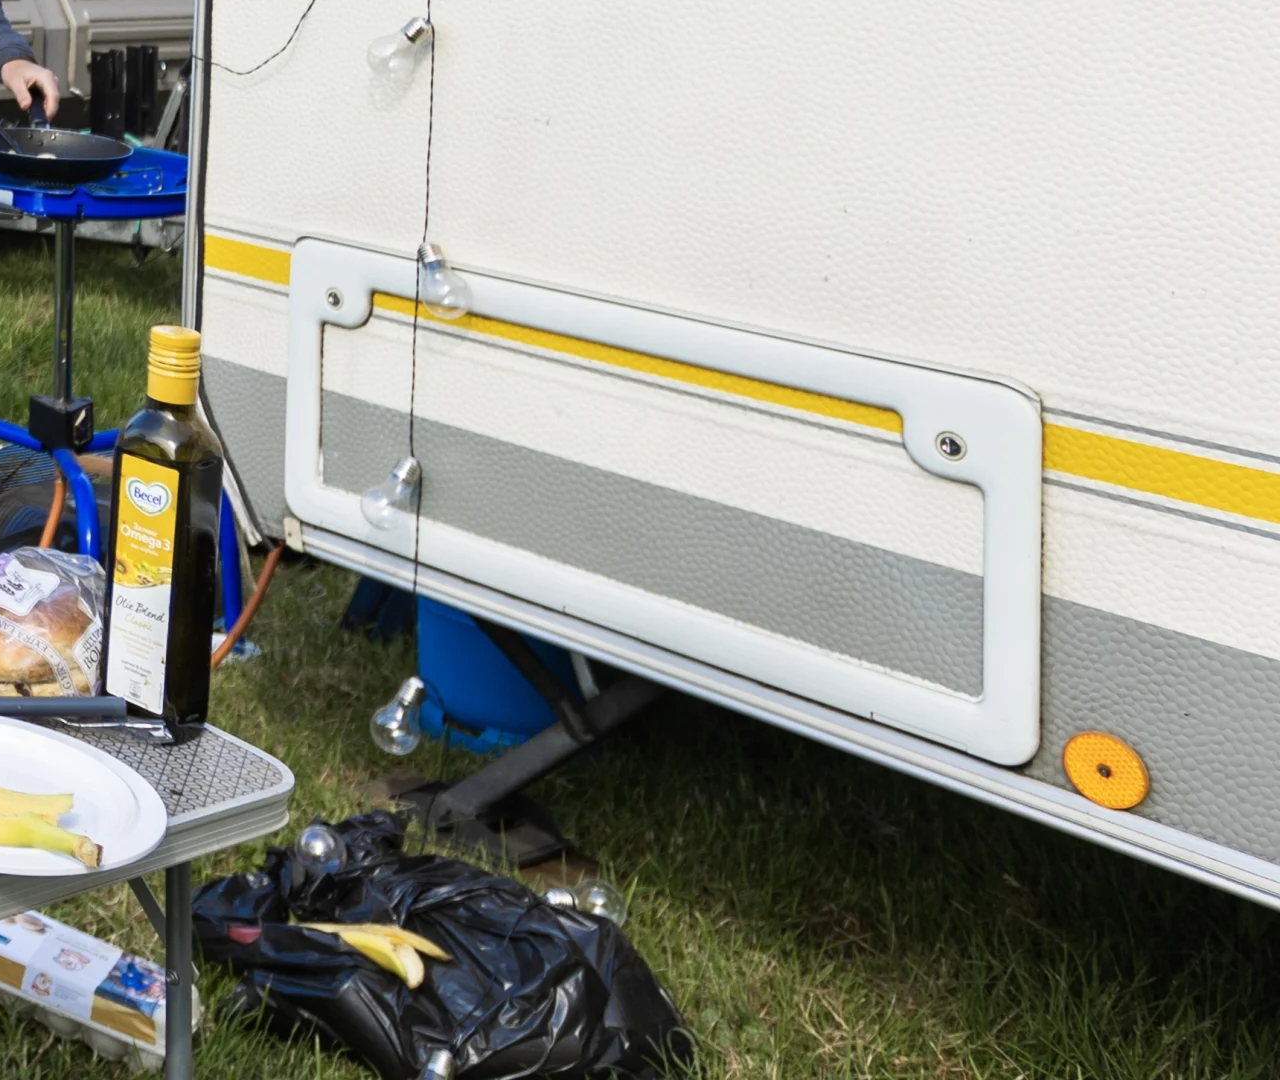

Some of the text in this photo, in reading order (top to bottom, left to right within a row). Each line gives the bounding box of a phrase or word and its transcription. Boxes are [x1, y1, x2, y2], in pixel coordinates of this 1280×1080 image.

[133, 486, 162, 506] Becel
[120, 523, 171, 551] Omega 3
[115, 595, 166, 623] Olie Blend
[18, 632, 48, 652] EXTRA
